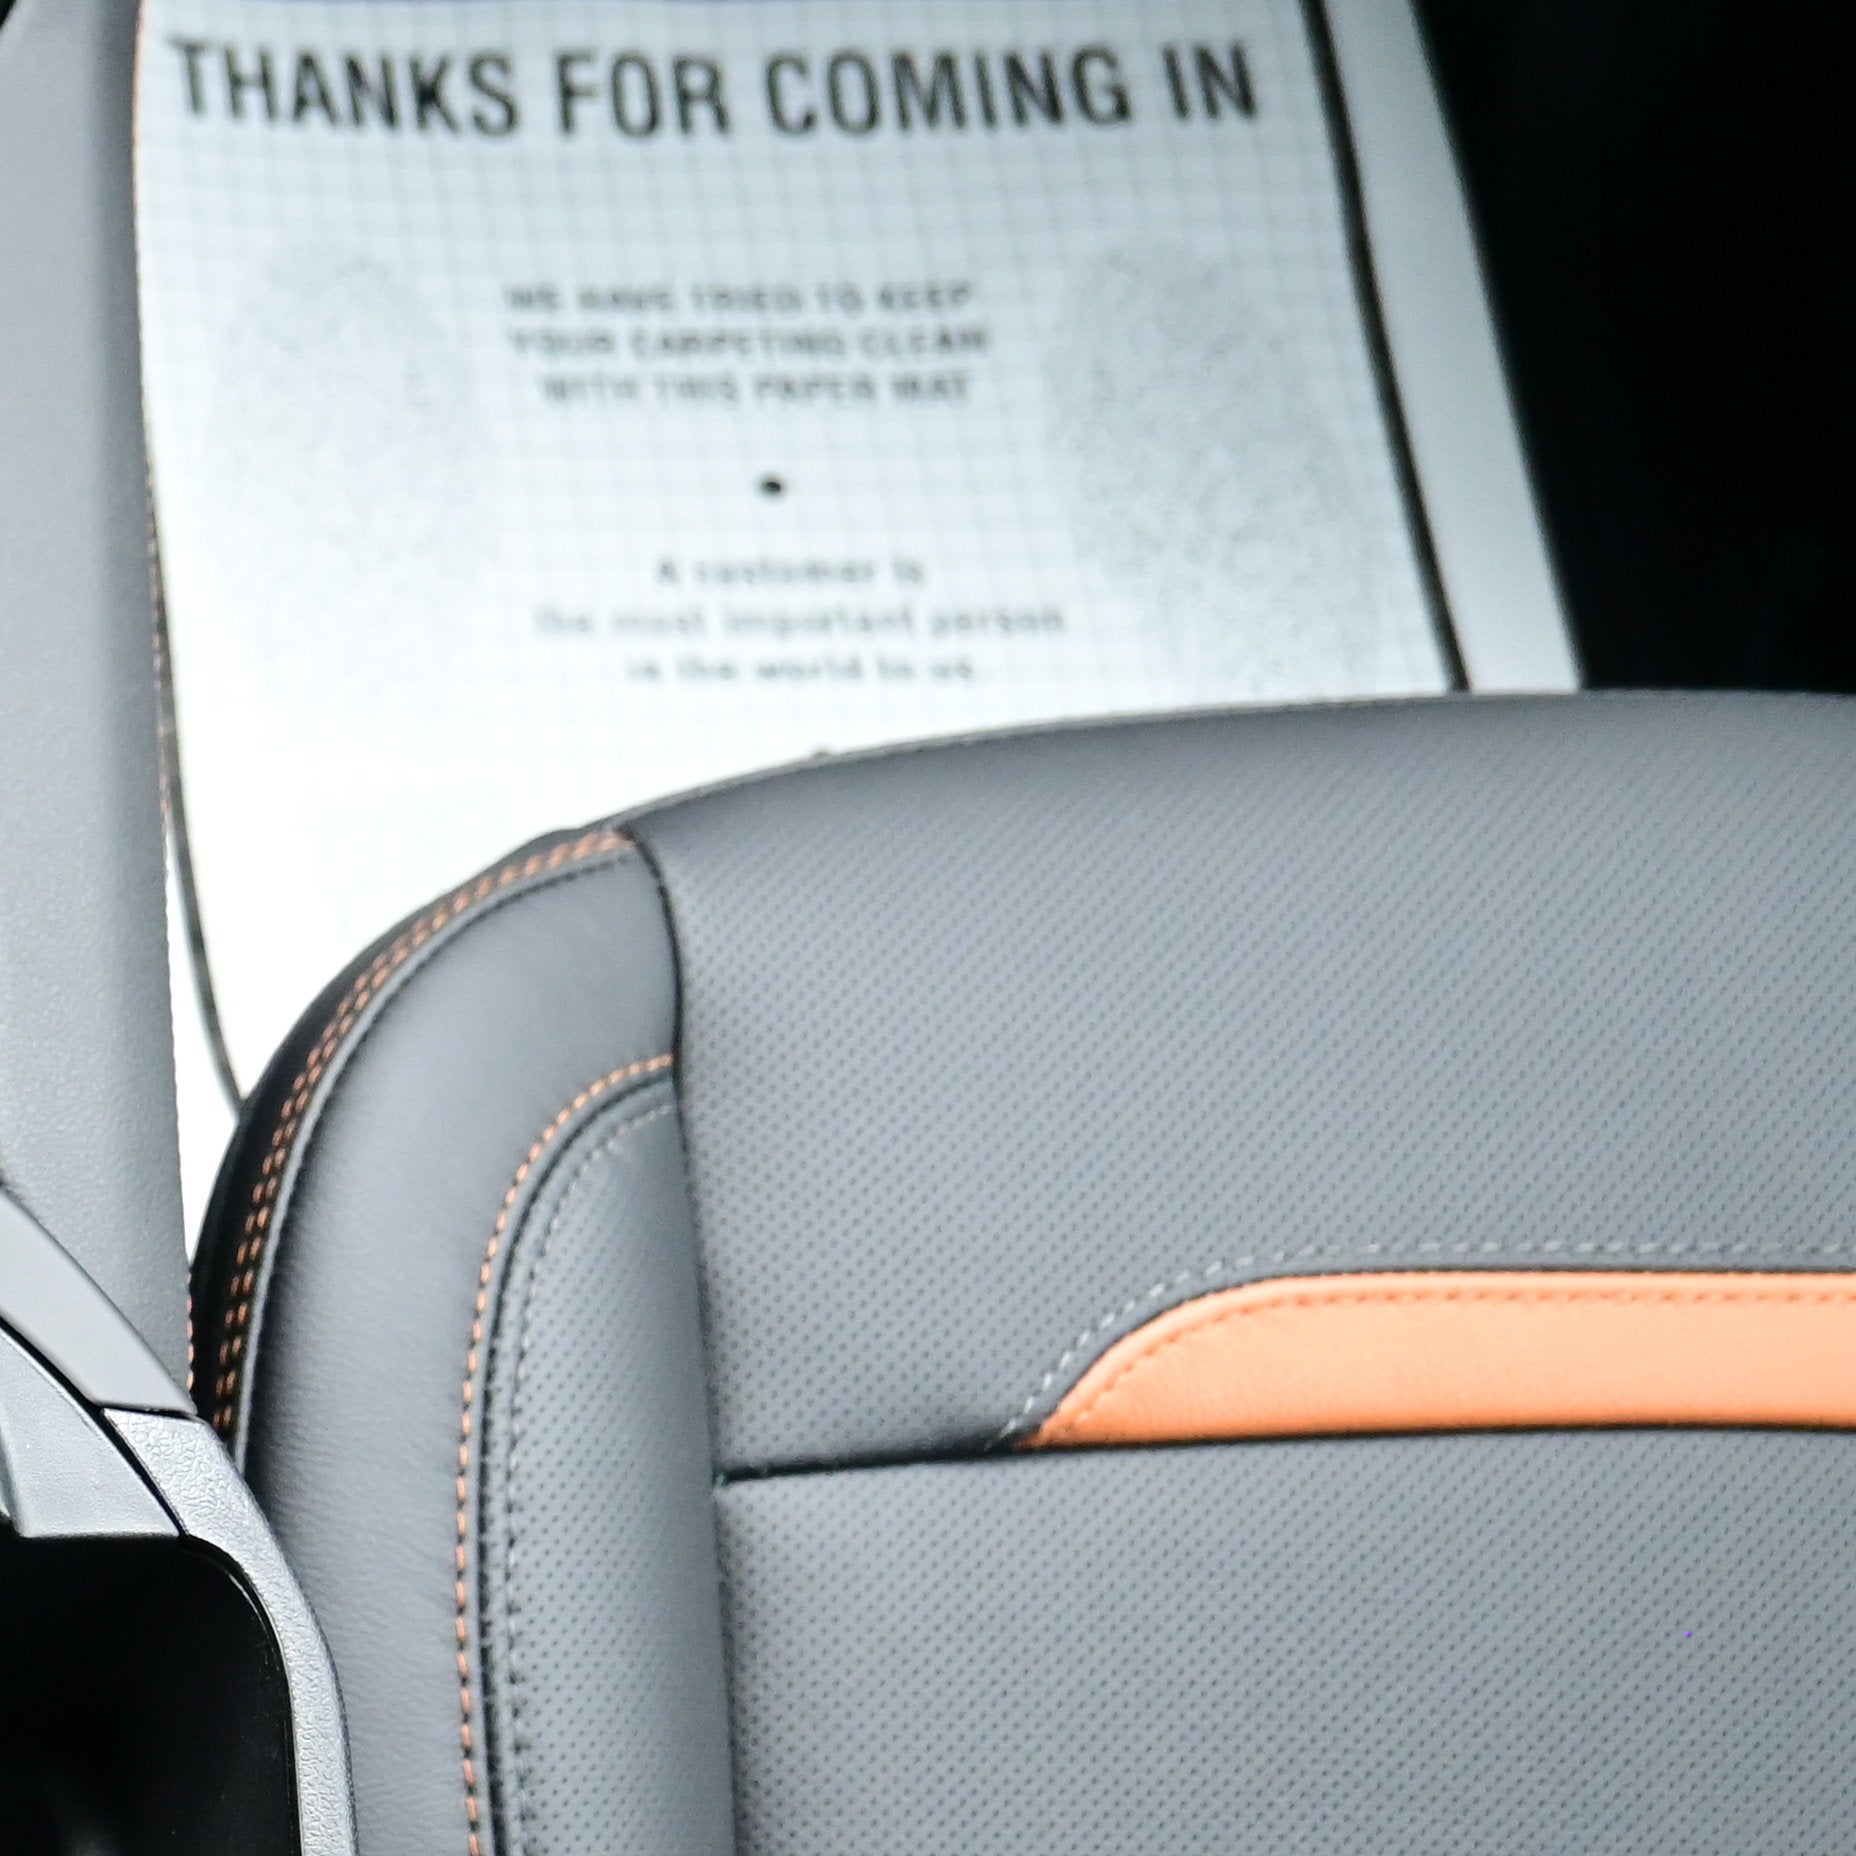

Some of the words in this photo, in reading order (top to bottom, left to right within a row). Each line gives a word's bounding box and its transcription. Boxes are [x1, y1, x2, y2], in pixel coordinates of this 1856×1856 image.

[169, 36, 518, 138] THANKS
[553, 46, 731, 138] FOR
[764, 42, 1132, 138] COMING
[1161, 41, 1258, 119] IN
[578, 282, 675, 313] HAVE
[690, 282, 805, 313] TRIED
[876, 277, 974, 312] KEEP
[752, 371, 878, 404] PAPER
[891, 369, 972, 402] MAT
